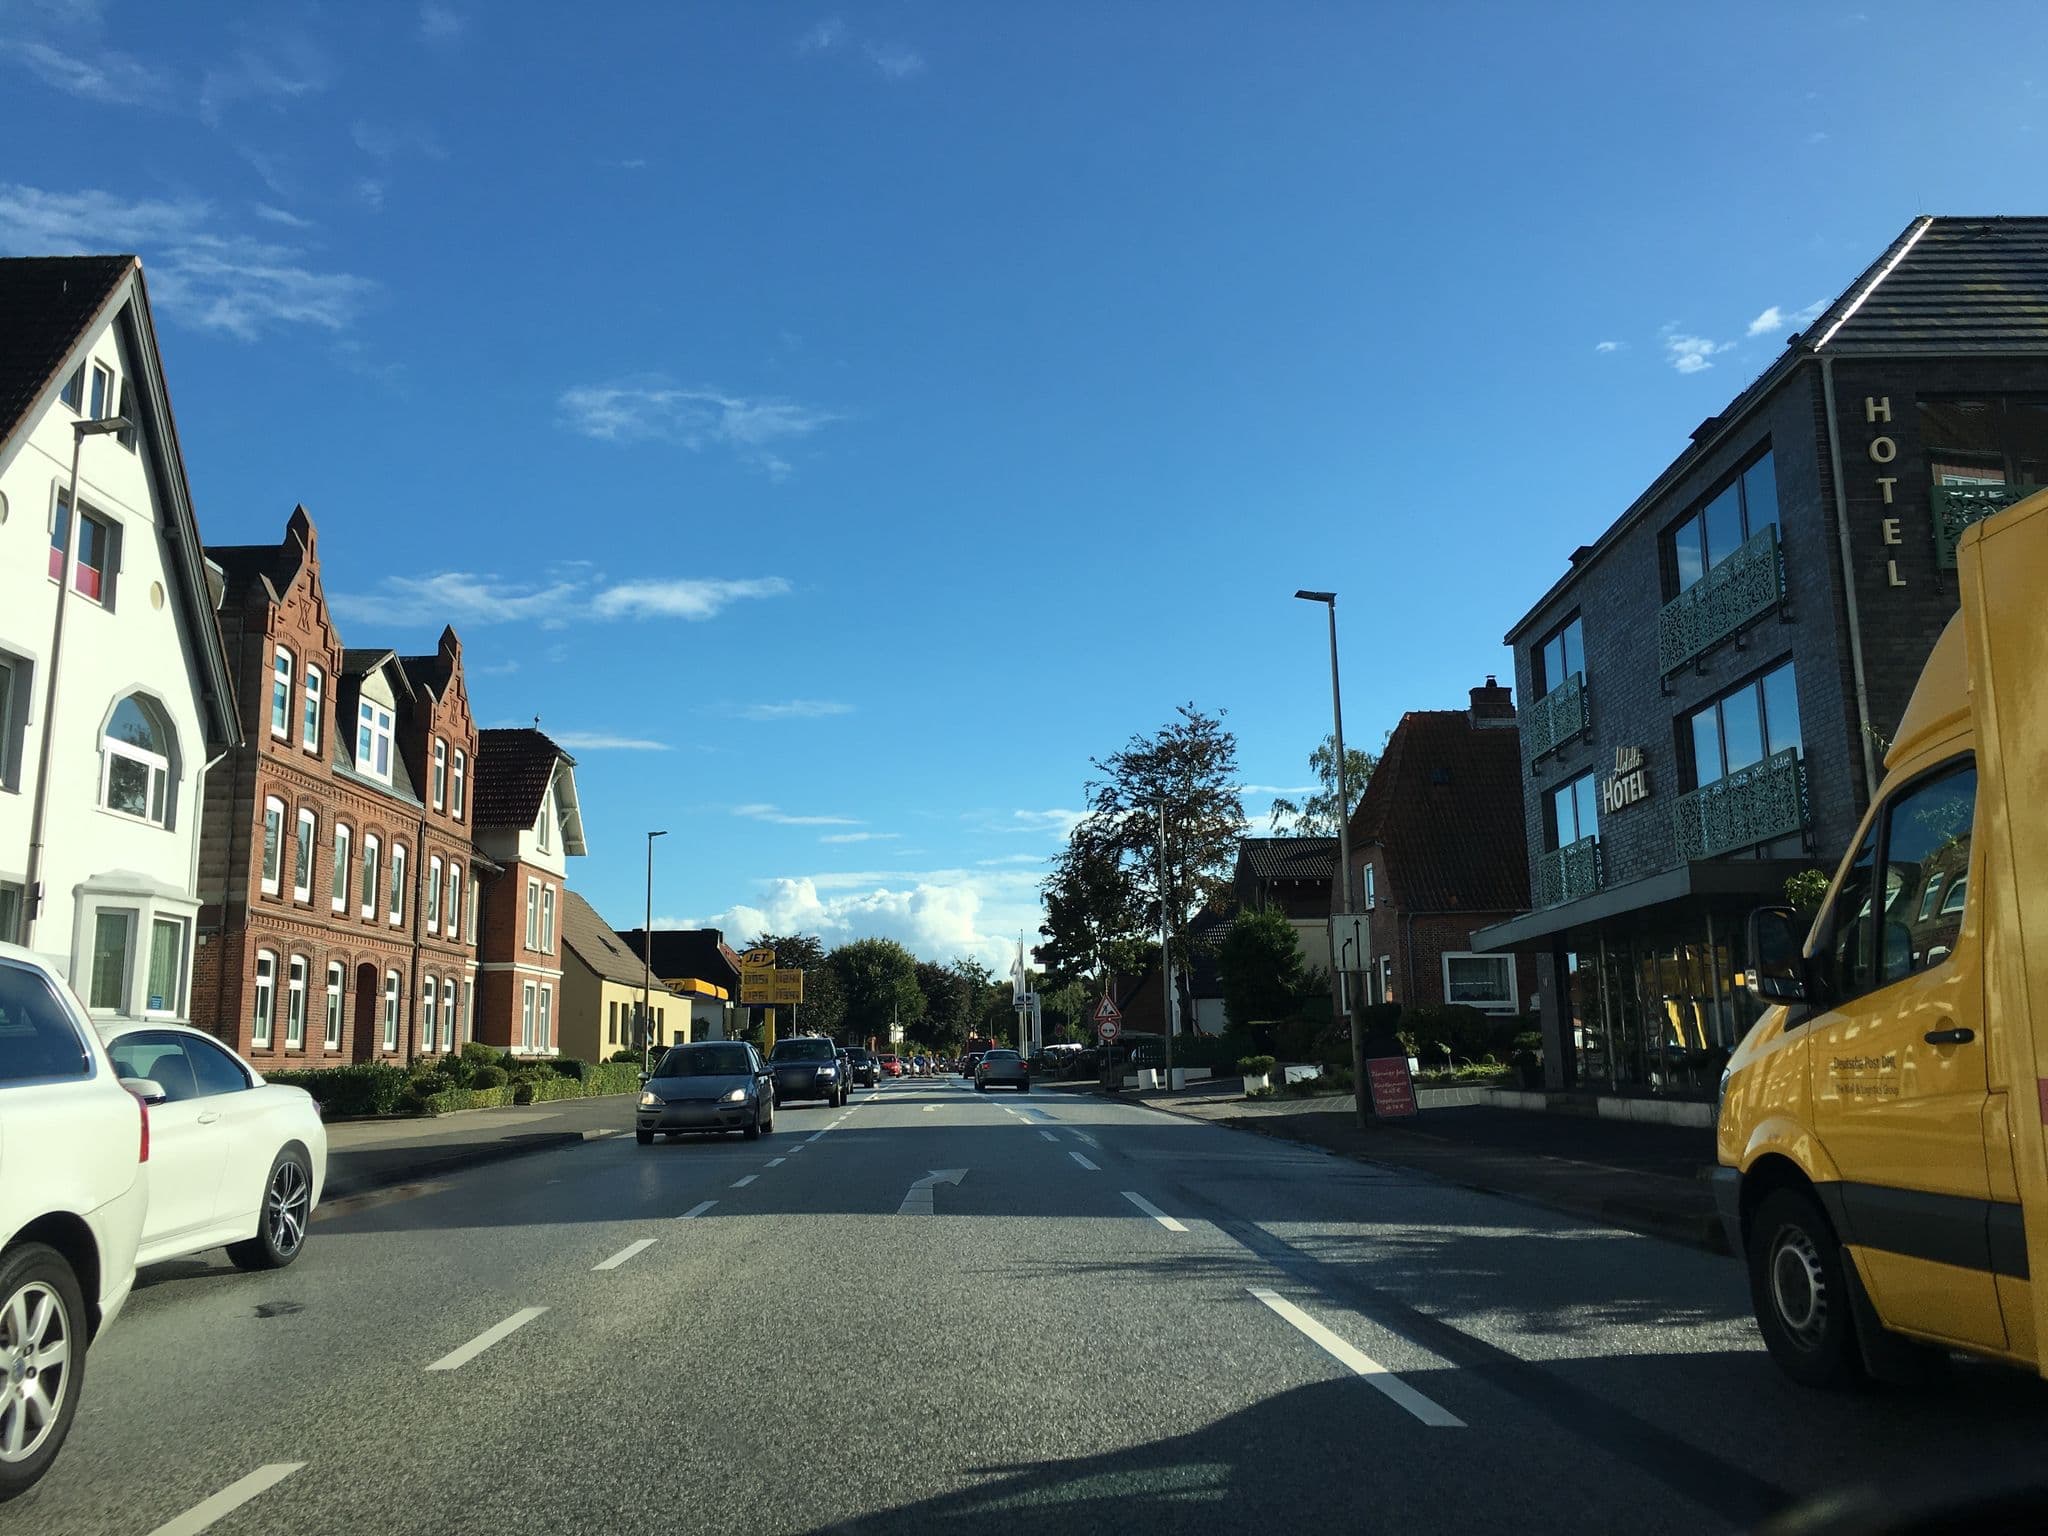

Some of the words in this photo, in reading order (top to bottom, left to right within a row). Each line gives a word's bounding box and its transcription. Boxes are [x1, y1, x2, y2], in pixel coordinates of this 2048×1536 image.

[1865, 396, 1906, 587] HOTEL
[1602, 770, 1649, 815] HOTEL
[746, 953, 769, 963] JET
